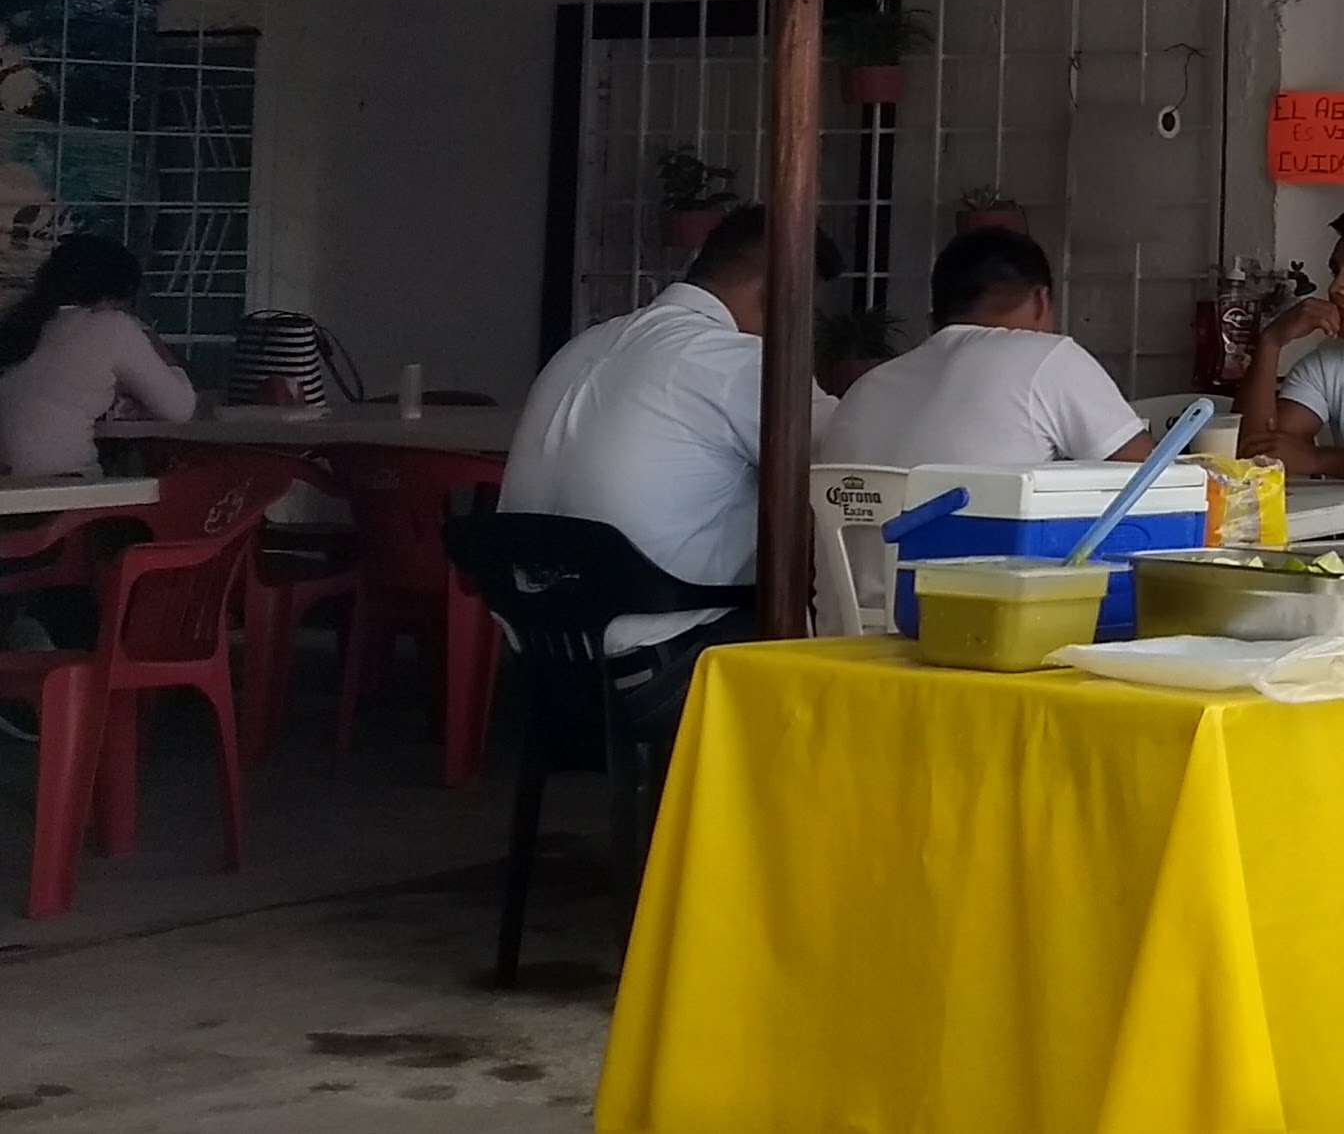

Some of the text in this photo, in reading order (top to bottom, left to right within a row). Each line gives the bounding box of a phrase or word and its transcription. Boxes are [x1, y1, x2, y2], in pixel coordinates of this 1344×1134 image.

[1273, 94, 1307, 121] EL
[826, 486, 882, 507] Corona
[843, 504, 874, 517] Extra
